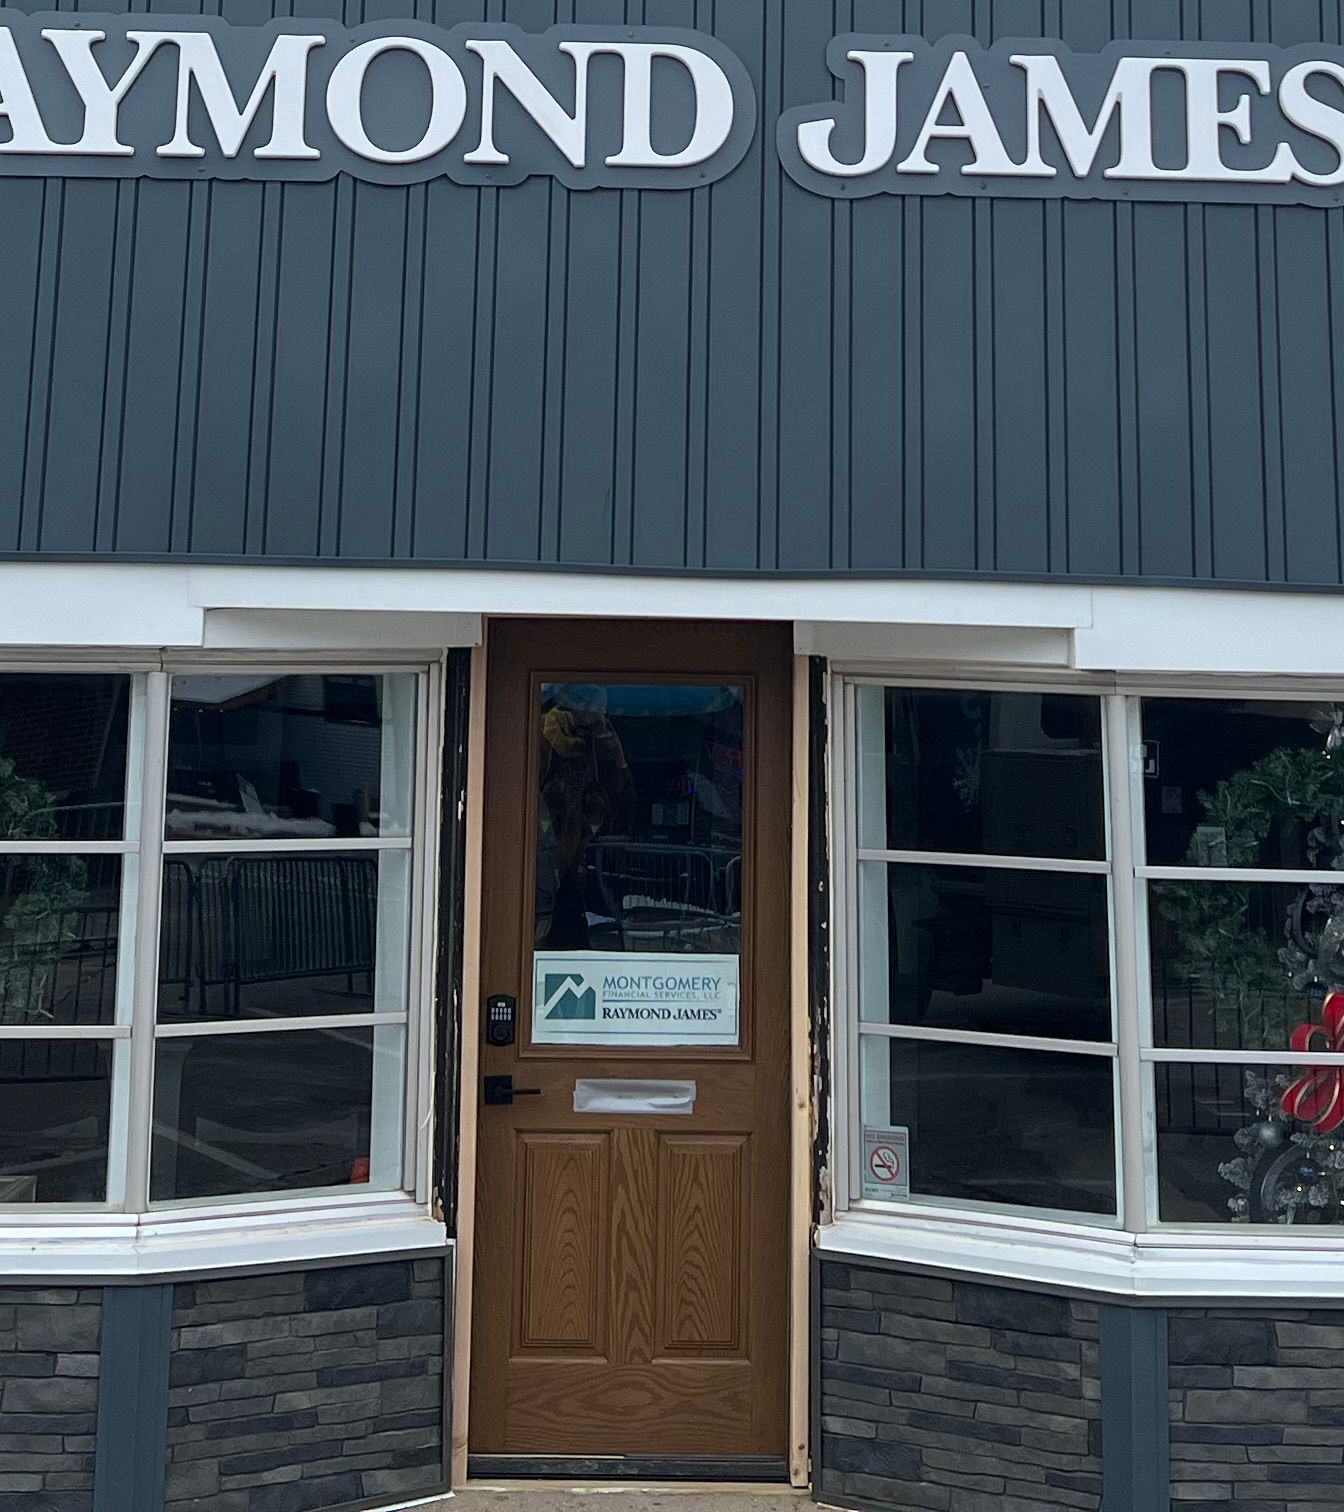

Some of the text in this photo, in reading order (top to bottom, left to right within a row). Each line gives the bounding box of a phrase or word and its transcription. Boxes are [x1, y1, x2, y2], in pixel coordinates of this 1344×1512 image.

[602, 975, 723, 991] MONTGOMERY
[602, 991, 651, 999] FINANCIAL
[602, 1007, 671, 1020] RAYMOND
